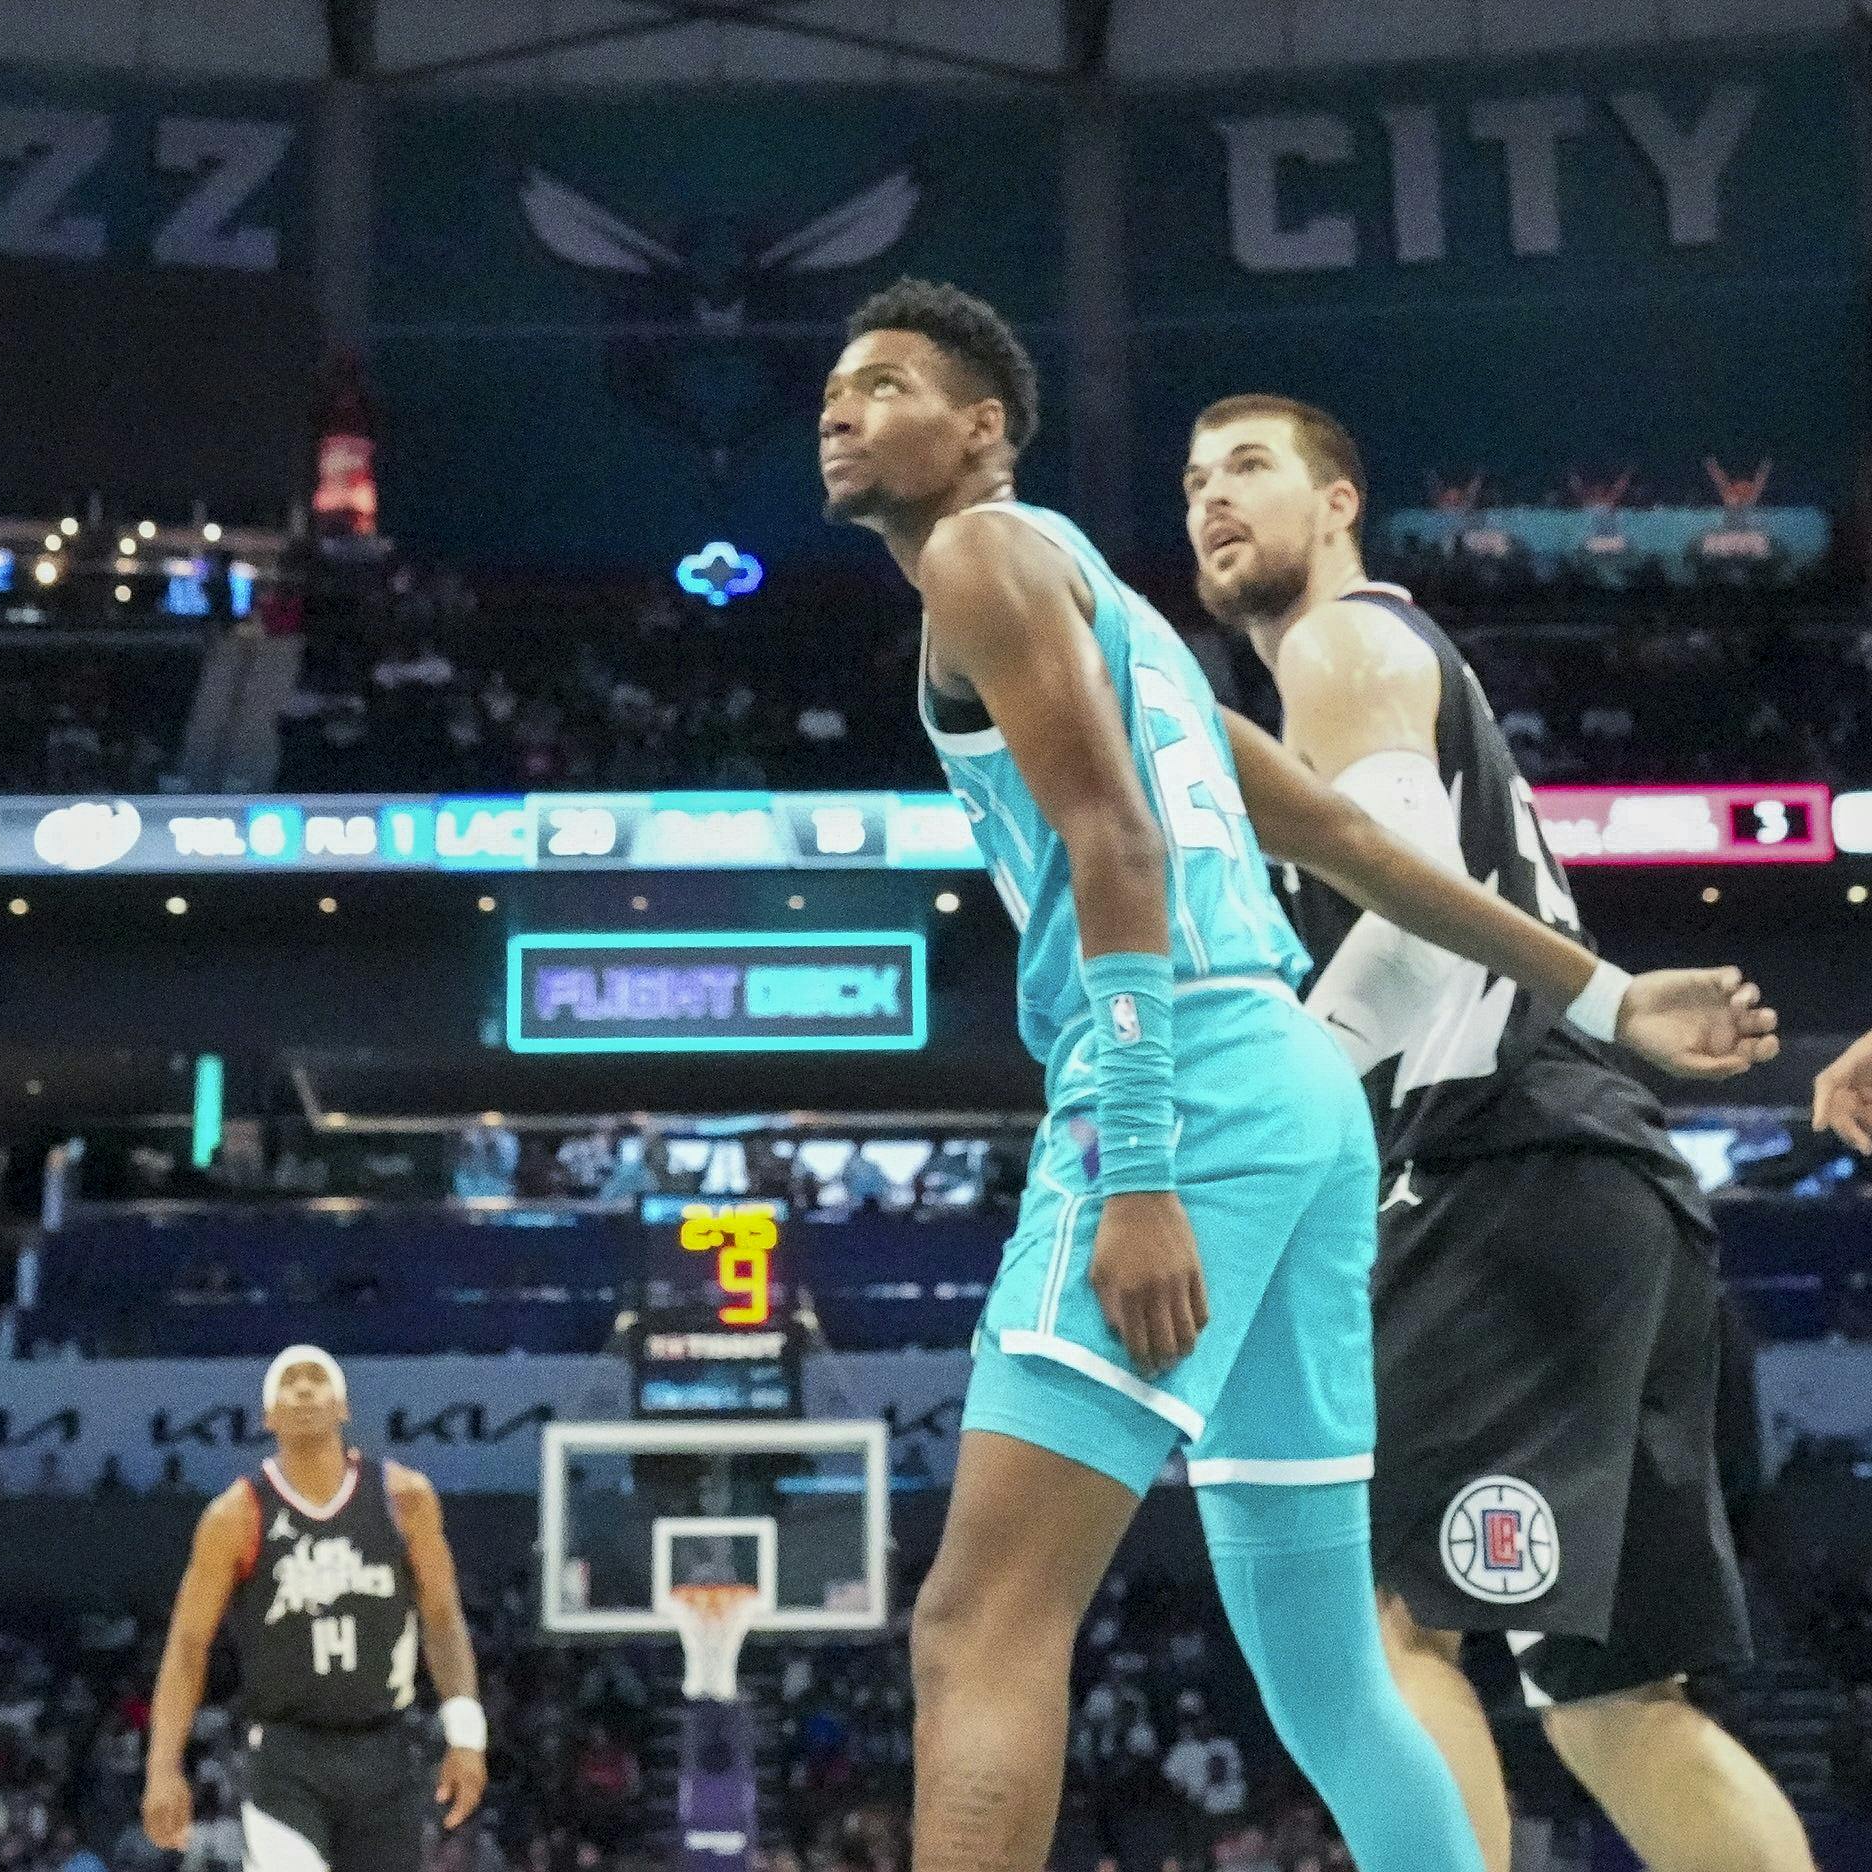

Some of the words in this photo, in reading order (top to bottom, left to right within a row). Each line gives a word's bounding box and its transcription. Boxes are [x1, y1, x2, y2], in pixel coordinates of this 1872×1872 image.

[1220, 88, 1760, 270] CITY
[536, 965, 738, 1021] FLIGHT
[718, 1247, 771, 1324] 9
[152, 1405, 274, 1448] KI
[388, 1403, 554, 1446] KIA
[311, 1614, 357, 1675] 14
